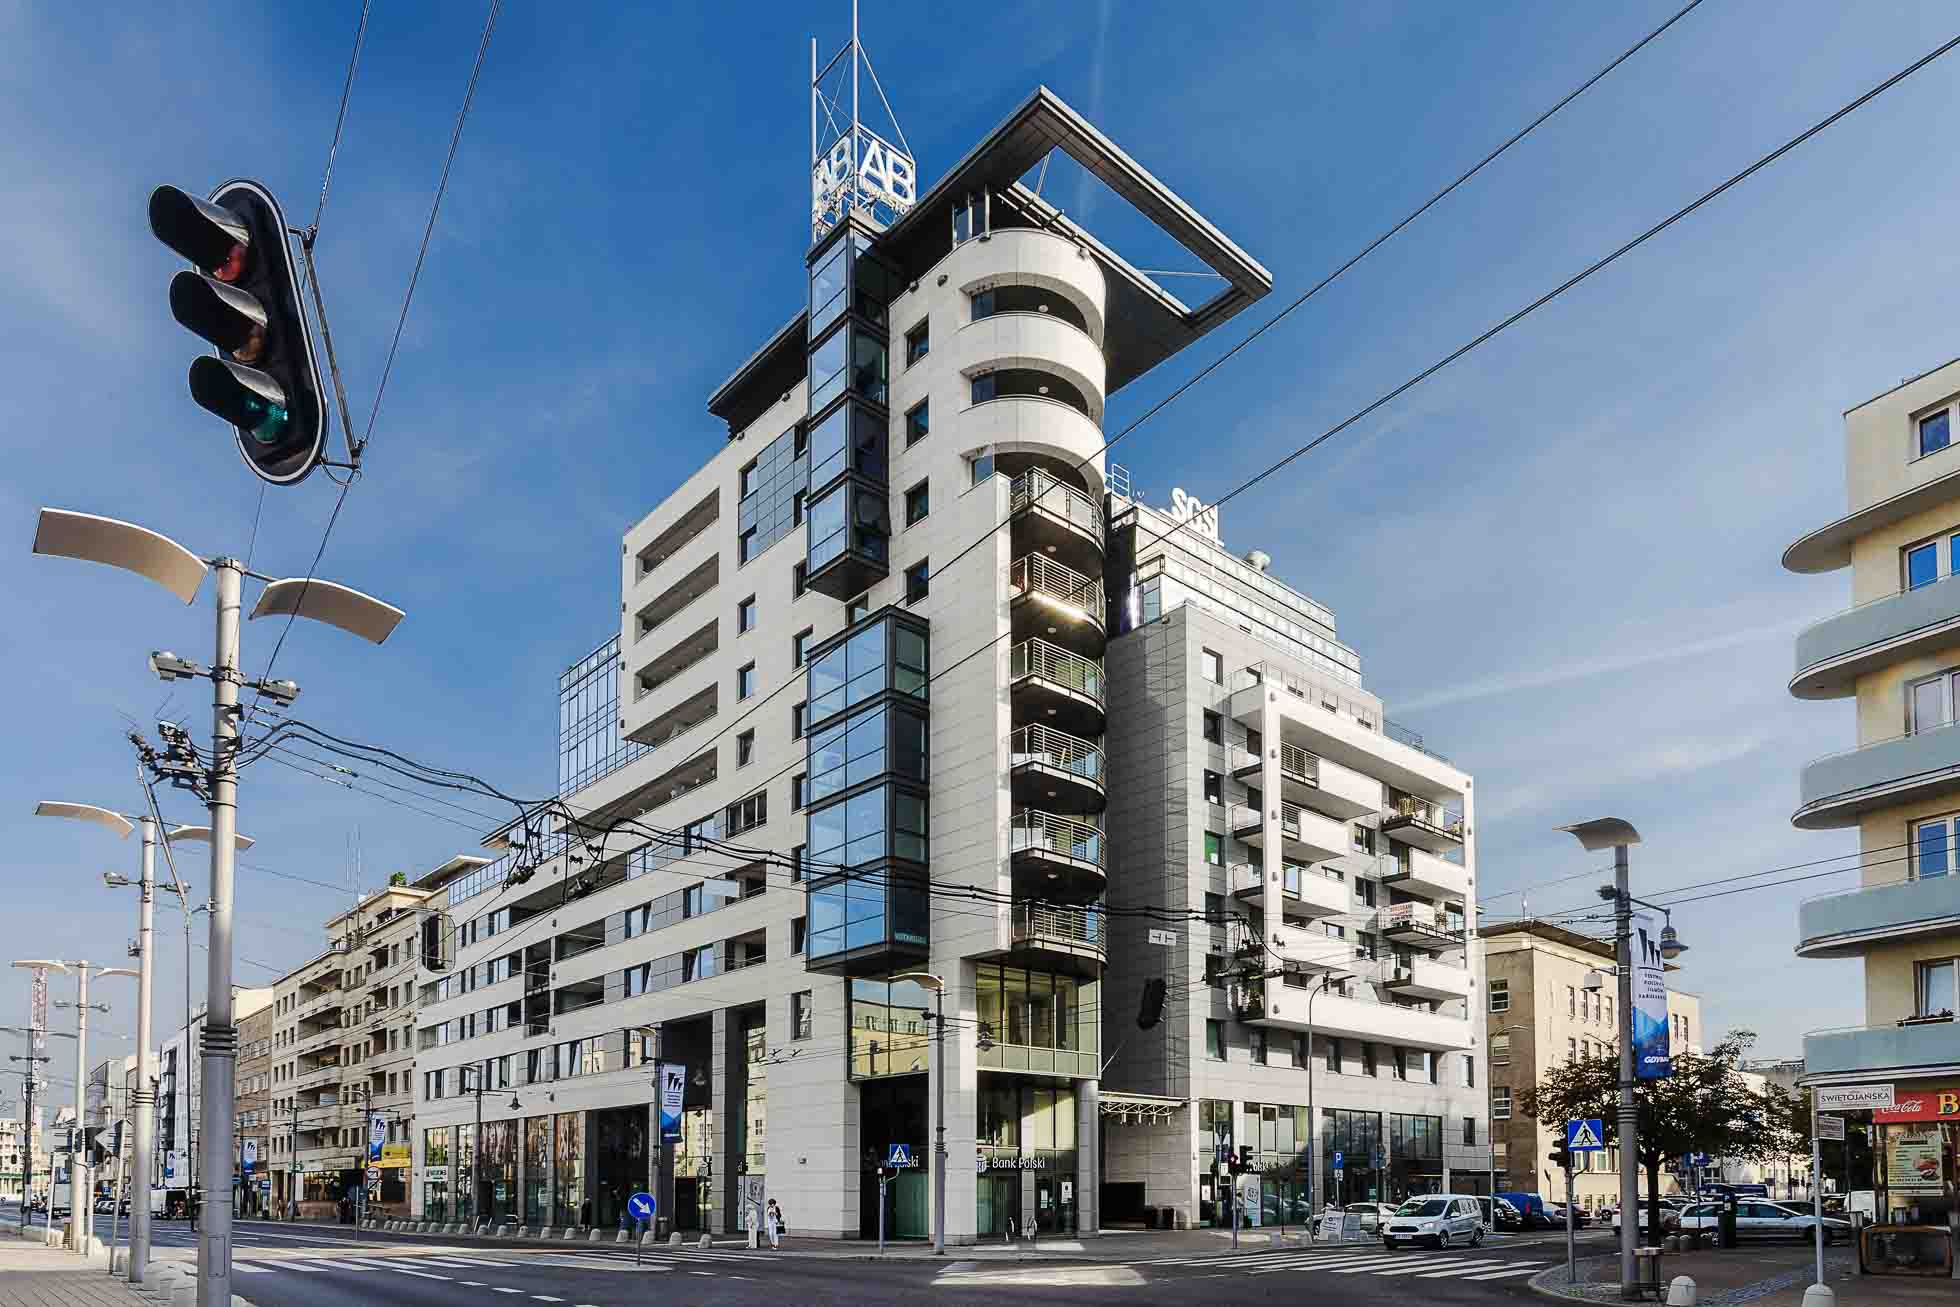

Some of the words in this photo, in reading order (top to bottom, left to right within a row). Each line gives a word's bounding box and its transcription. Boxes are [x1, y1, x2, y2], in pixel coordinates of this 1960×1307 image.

[859, 138, 914, 206] AB
[992, 1156, 1016, 1169] Bank
[1018, 1156, 1045, 1169] Polski
